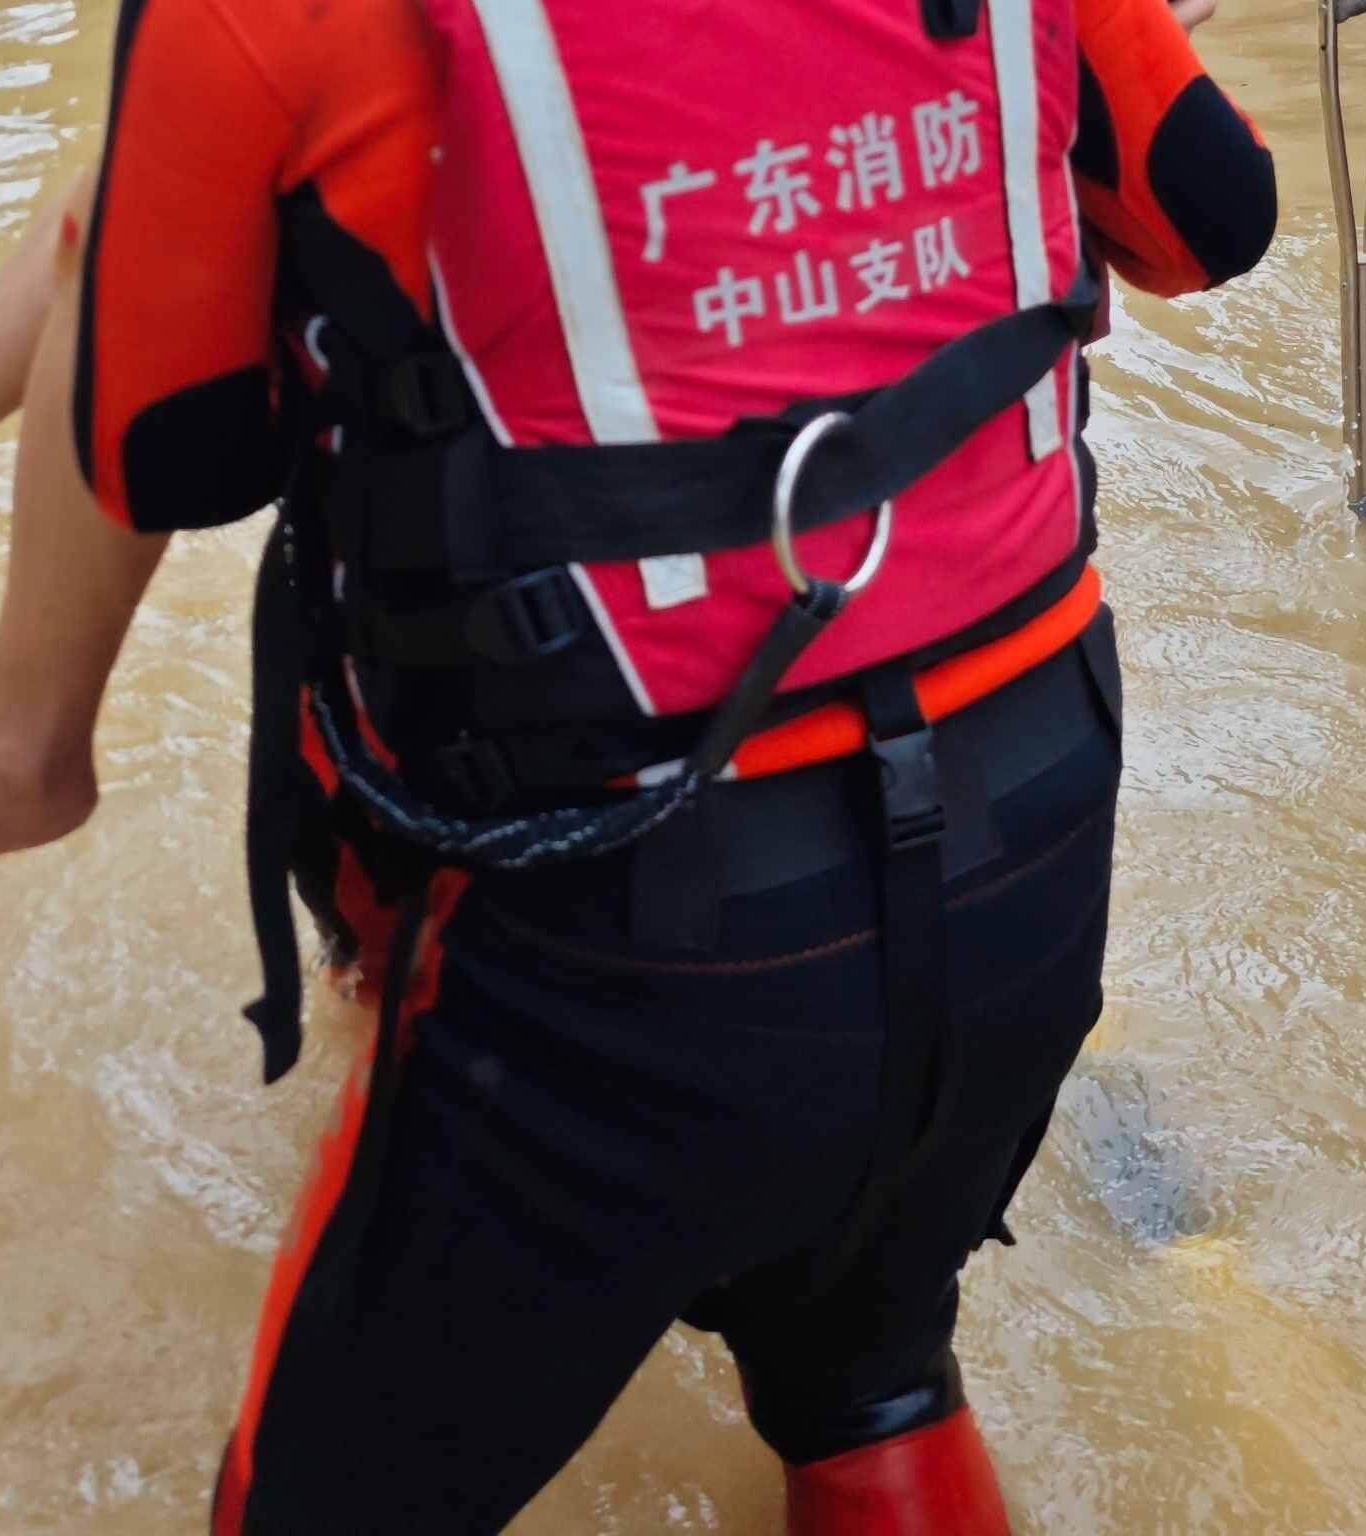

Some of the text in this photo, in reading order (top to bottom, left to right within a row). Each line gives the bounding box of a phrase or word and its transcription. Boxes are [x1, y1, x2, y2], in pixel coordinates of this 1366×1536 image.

[639, 90, 983, 263] 广东消防
[693, 215, 972, 349] 中山支队
